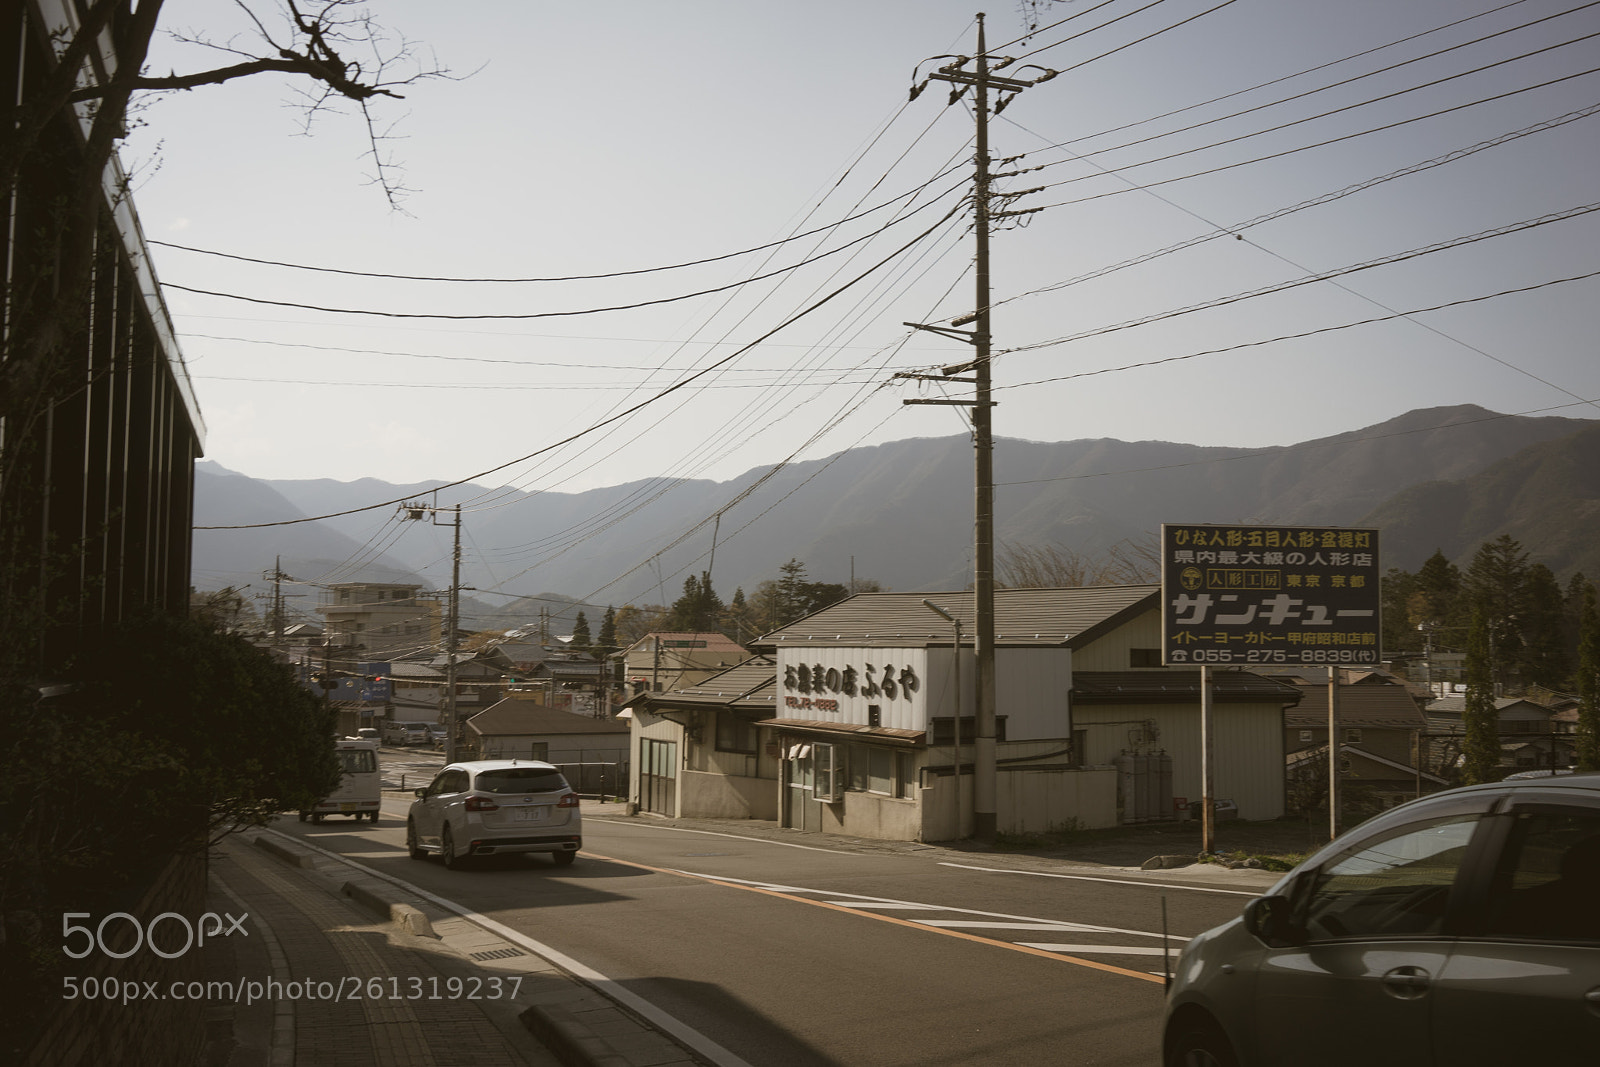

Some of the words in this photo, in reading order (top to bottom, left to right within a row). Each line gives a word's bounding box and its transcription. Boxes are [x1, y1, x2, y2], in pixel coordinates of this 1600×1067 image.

[1174, 550, 1373, 567] 県内最大級の人形店
[1210, 571, 1278, 587] 人形工房
[1286, 574, 1321, 588] 東京
[1331, 574, 1365, 588] 京都
[1171, 593, 1374, 625] サンキュー
[1171, 631, 1376, 645] イトーヨーカドー甲府昭和店前
